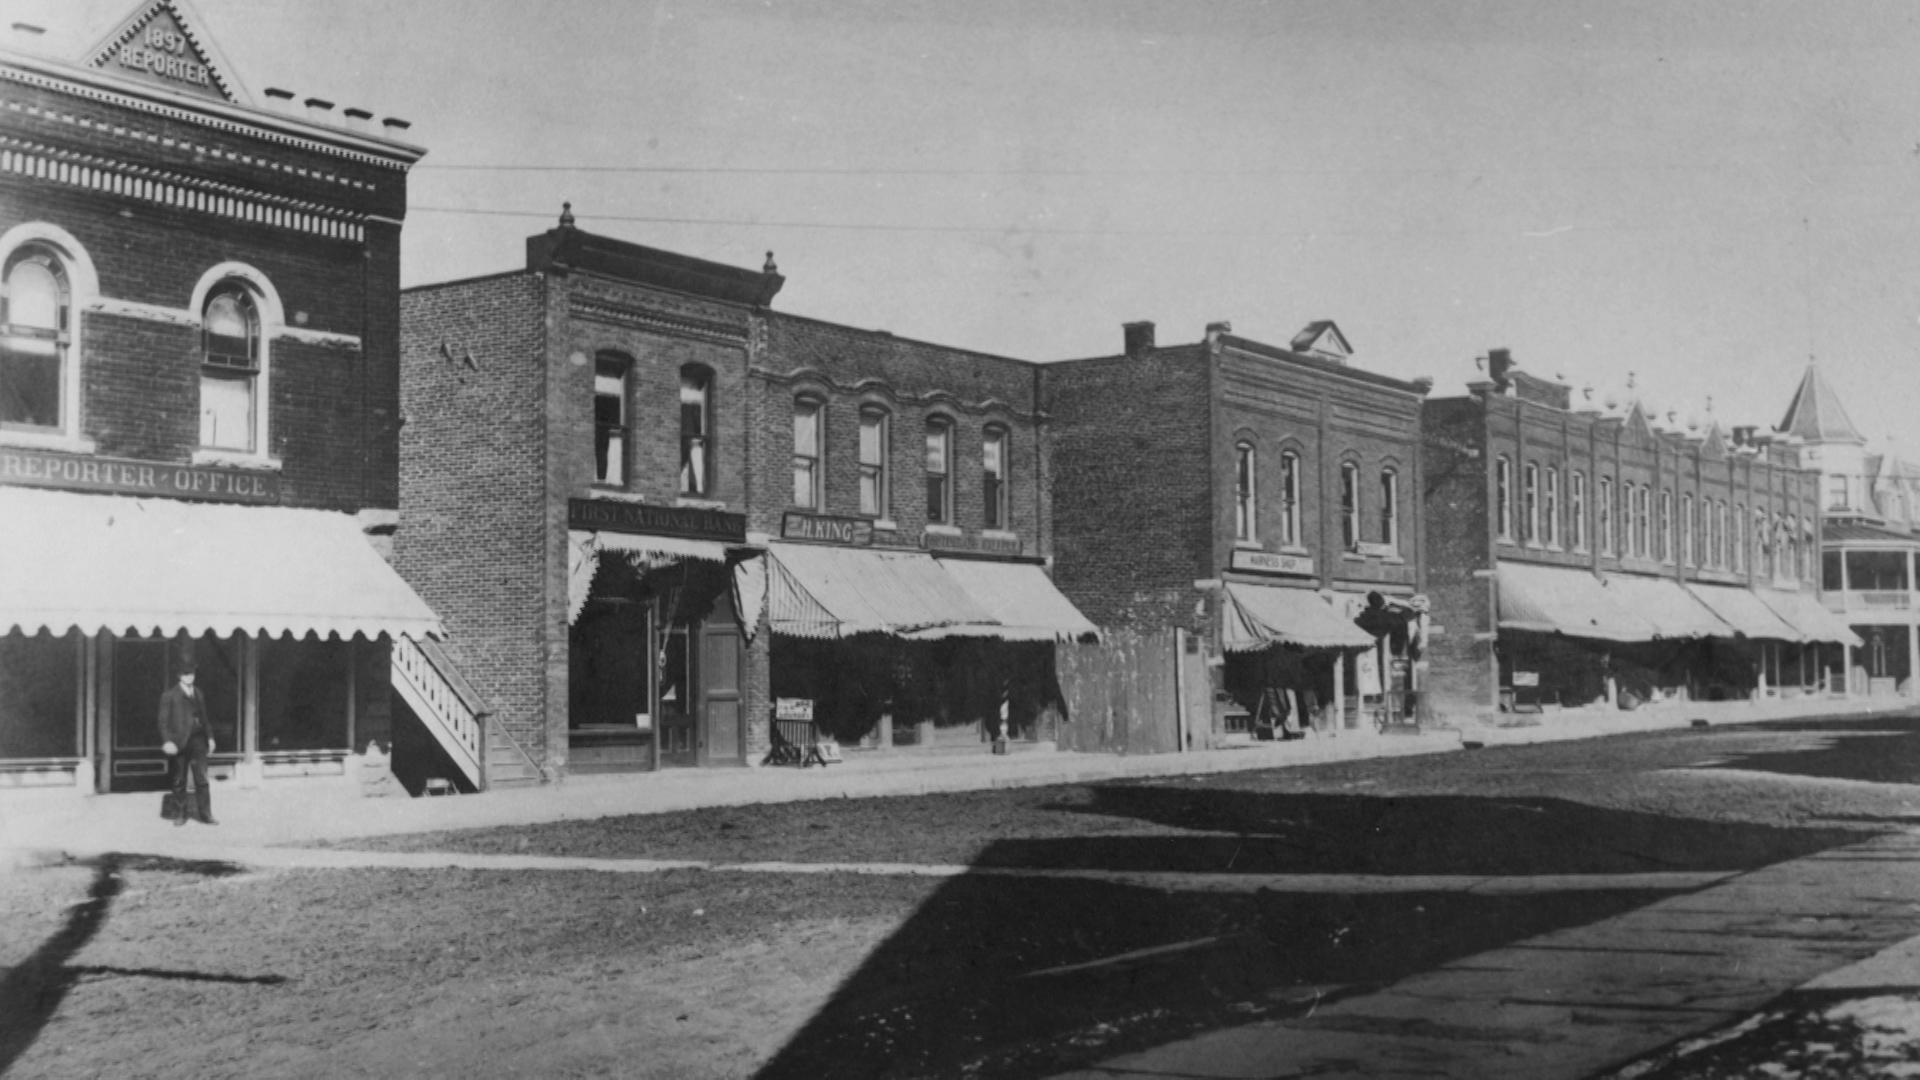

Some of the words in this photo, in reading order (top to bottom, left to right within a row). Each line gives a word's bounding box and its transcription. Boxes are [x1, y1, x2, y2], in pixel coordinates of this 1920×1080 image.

[144, 25, 185, 55] 1897
[120, 46, 209, 85] REPORTER
[2, 454, 156, 488] REPORTER
[570, 502, 618, 522] FIRST
